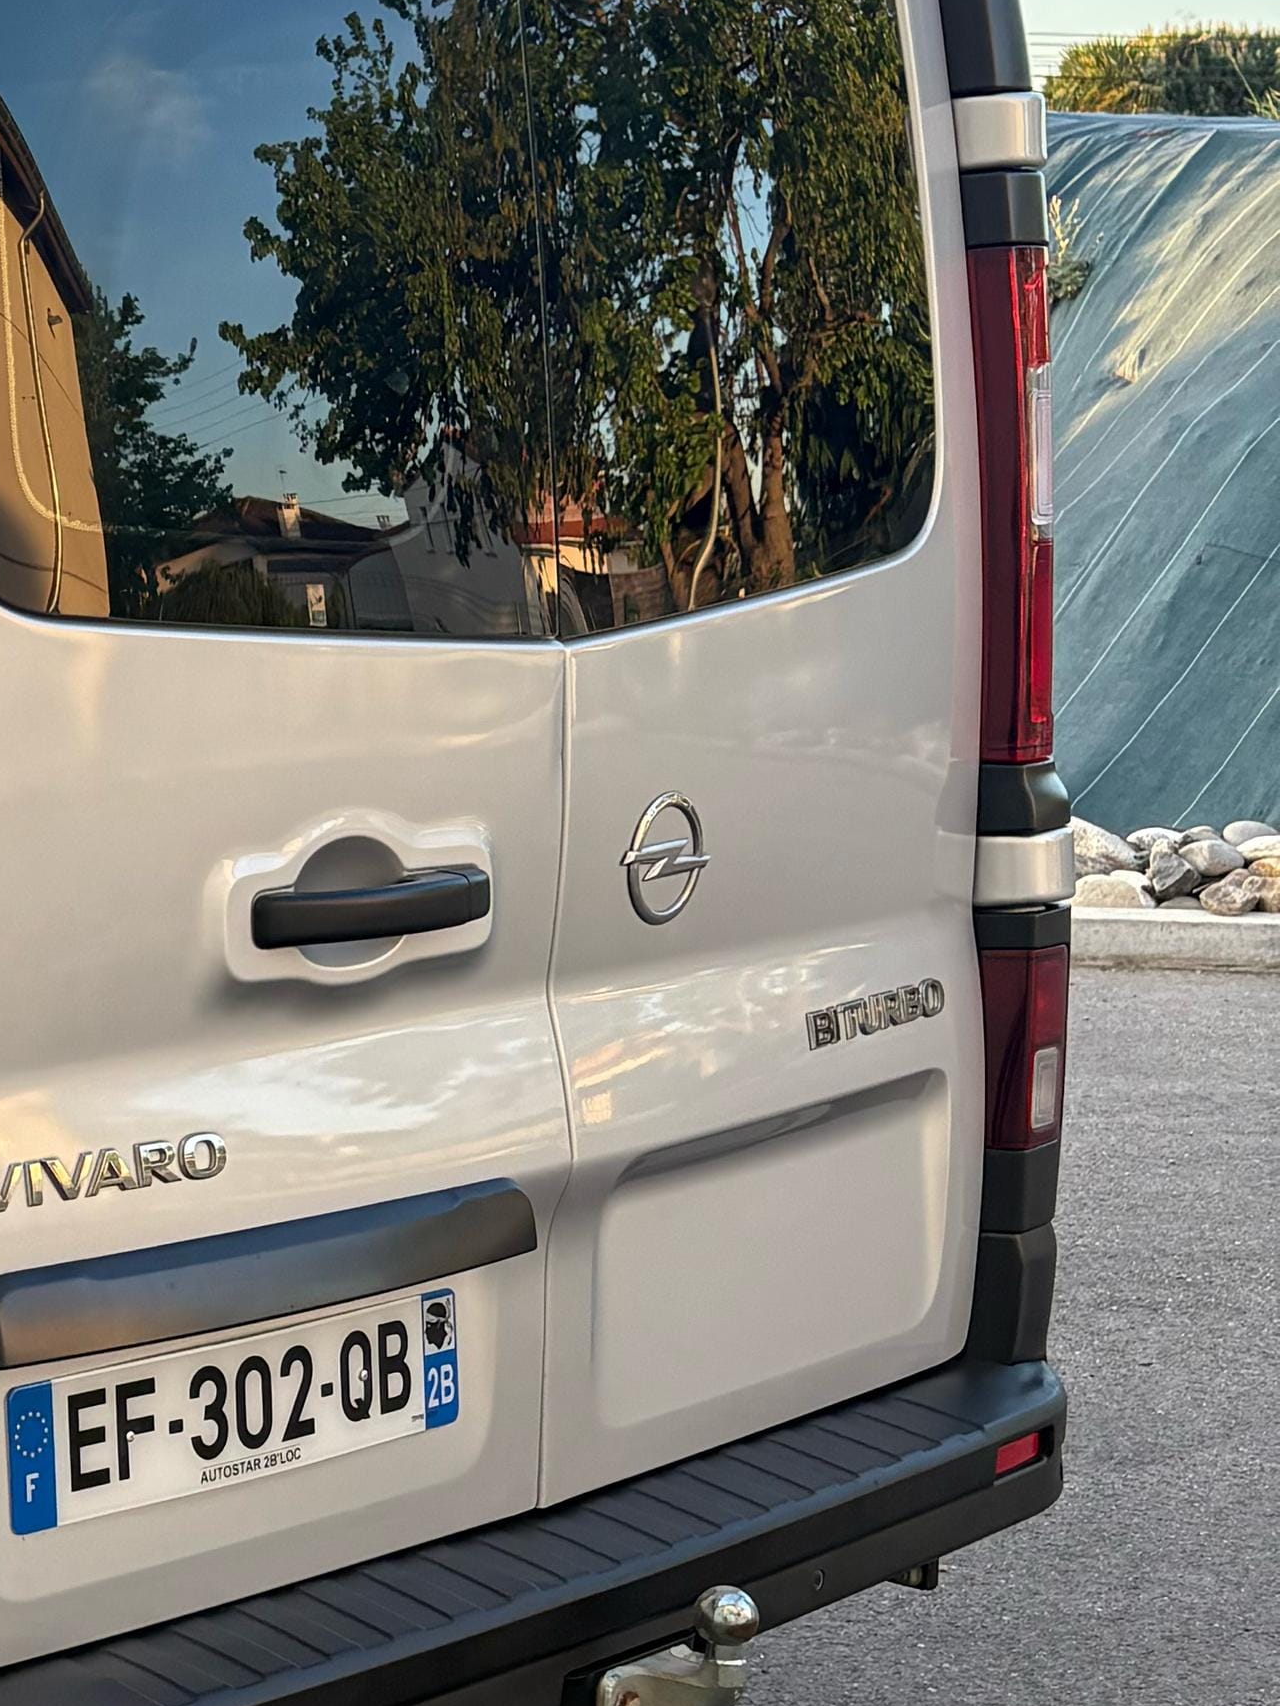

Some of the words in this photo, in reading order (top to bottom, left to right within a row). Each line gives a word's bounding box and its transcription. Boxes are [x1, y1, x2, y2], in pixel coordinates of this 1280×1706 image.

[805, 977, 945, 1051] BITURBO
[68, 1320, 411, 1492] EF-302-QB
[427, 1363, 455, 1408] 2B
[25, 1472, 40, 1503] F
[200, 1458, 261, 1484] AUTOSTAR
